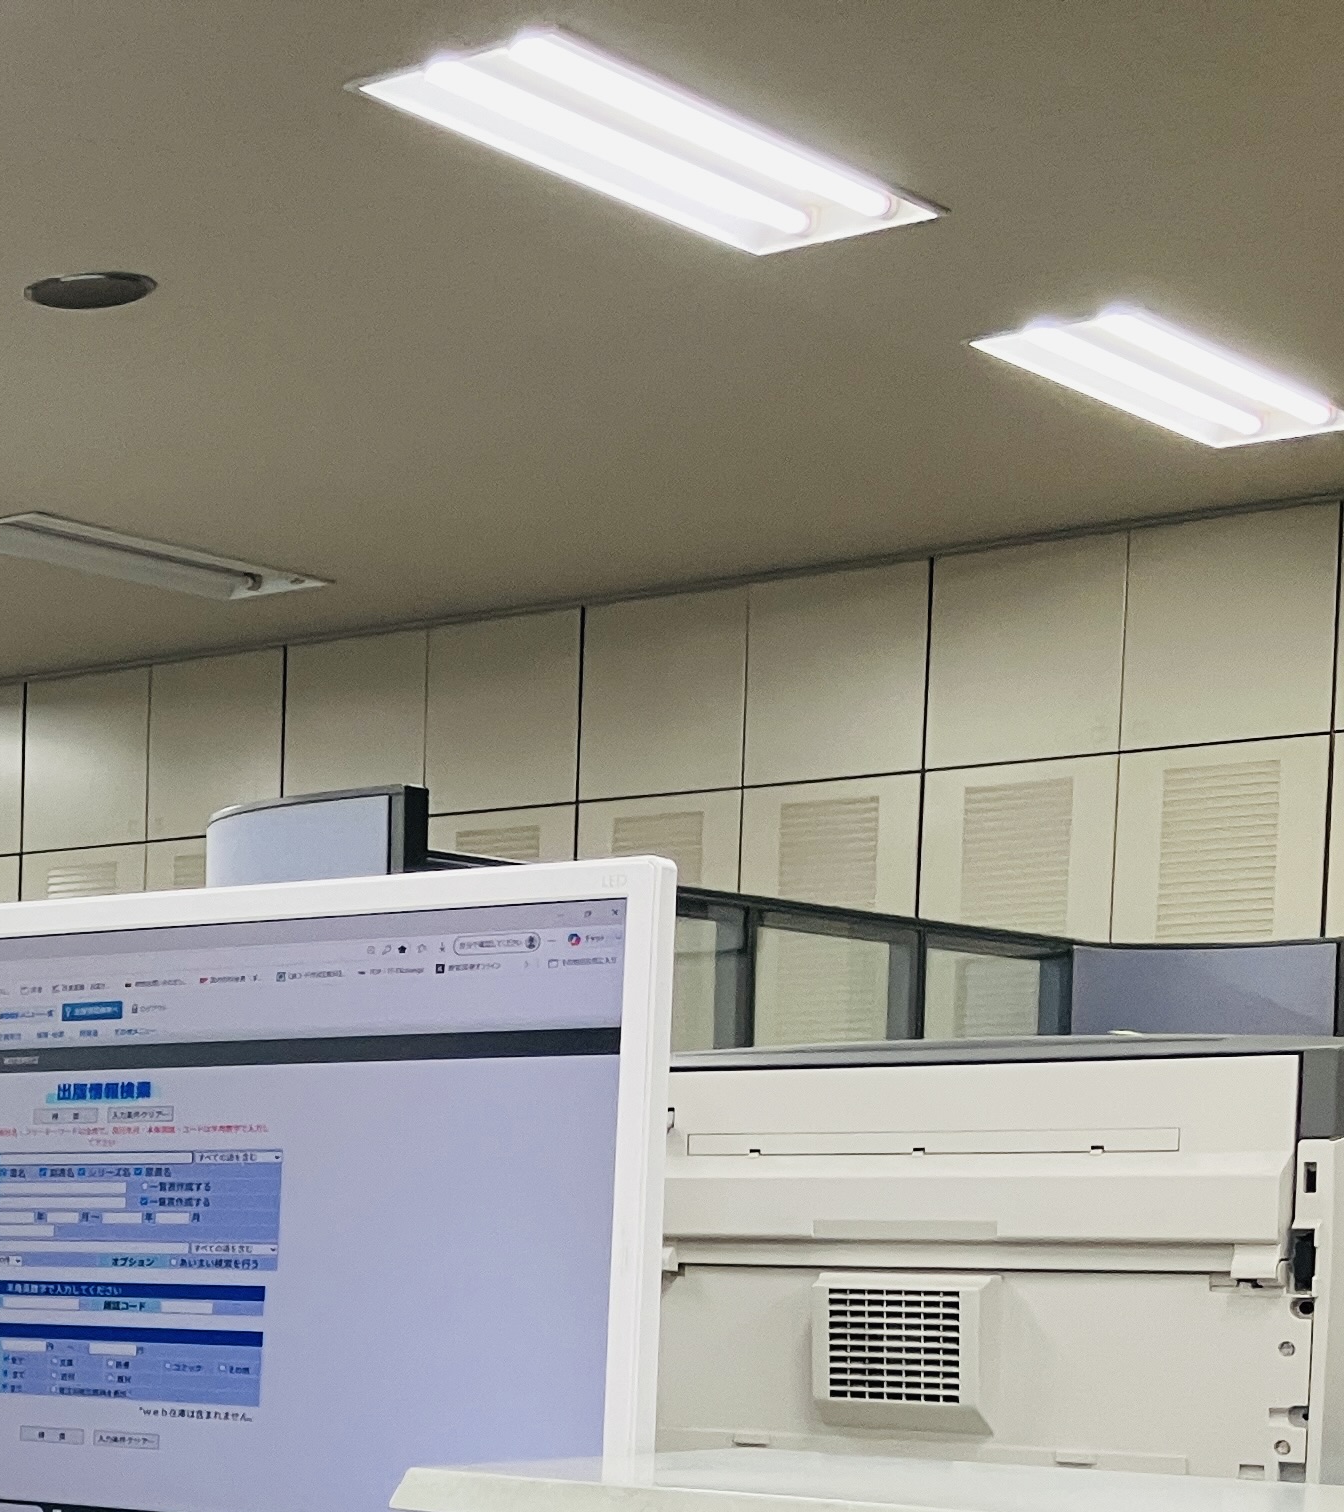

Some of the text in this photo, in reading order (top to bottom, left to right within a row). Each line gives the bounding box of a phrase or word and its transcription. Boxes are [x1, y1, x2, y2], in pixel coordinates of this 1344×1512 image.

[57, 1081, 152, 1101] 出版情報検索
[111, 1256, 155, 1268] オプション
